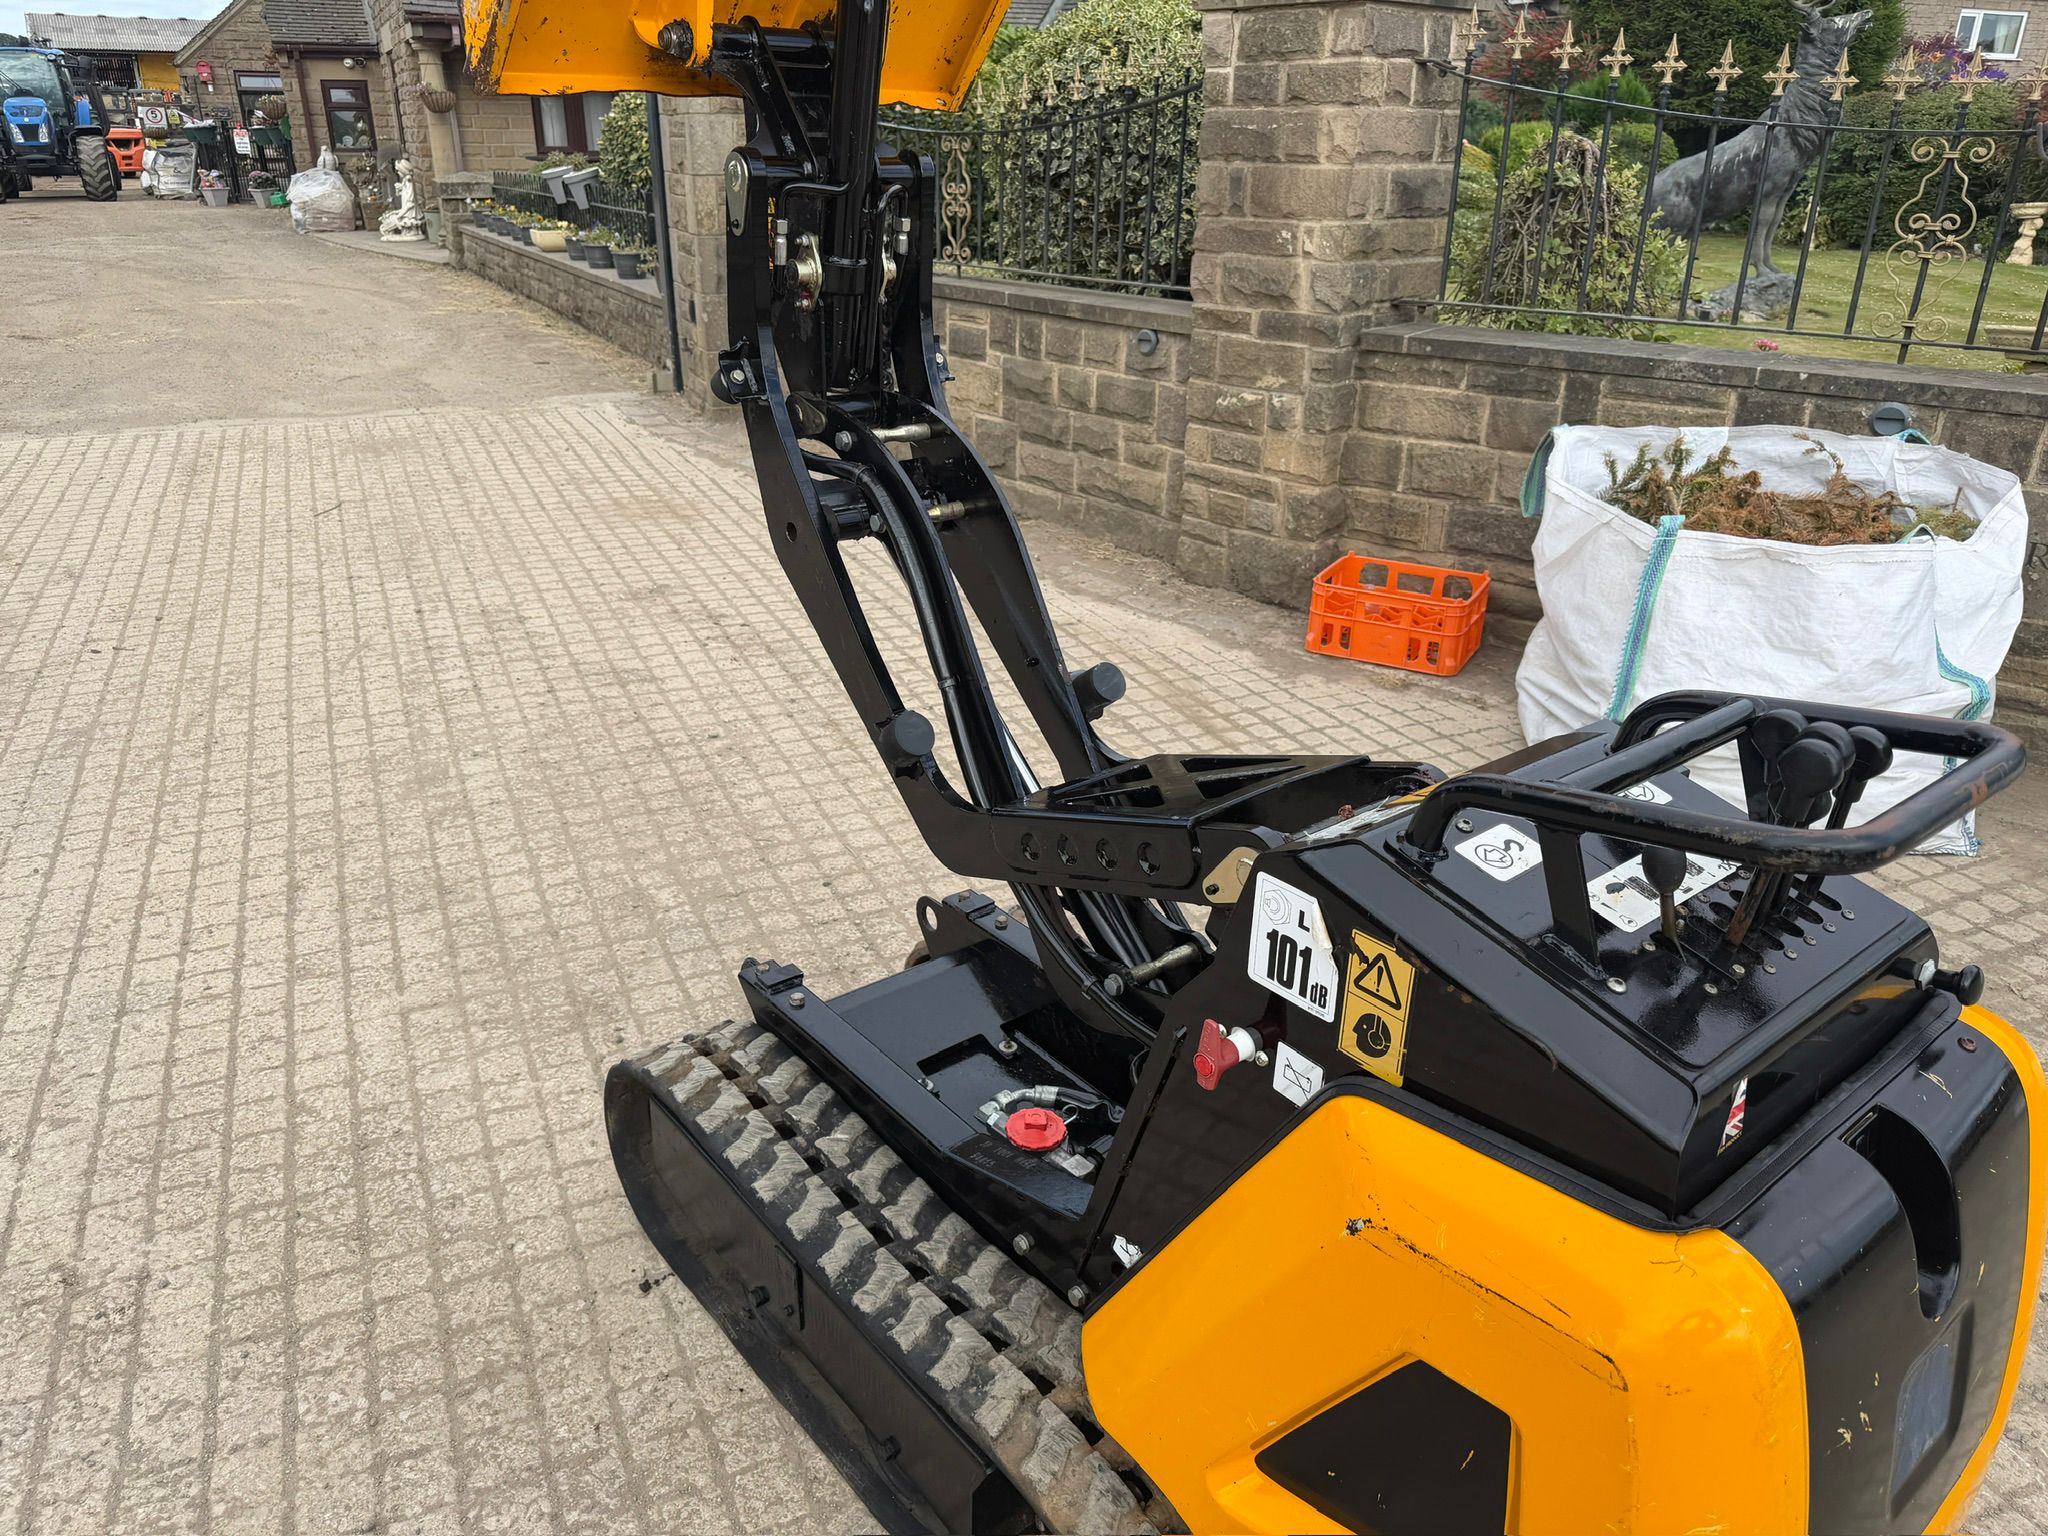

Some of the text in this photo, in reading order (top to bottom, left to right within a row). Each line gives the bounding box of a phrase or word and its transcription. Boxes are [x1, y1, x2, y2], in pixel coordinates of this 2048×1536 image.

[151, 111, 158, 119] 5
[1298, 910, 1310, 933] L
[1266, 928, 1312, 999] 101
[1309, 982, 1328, 1010] dB
